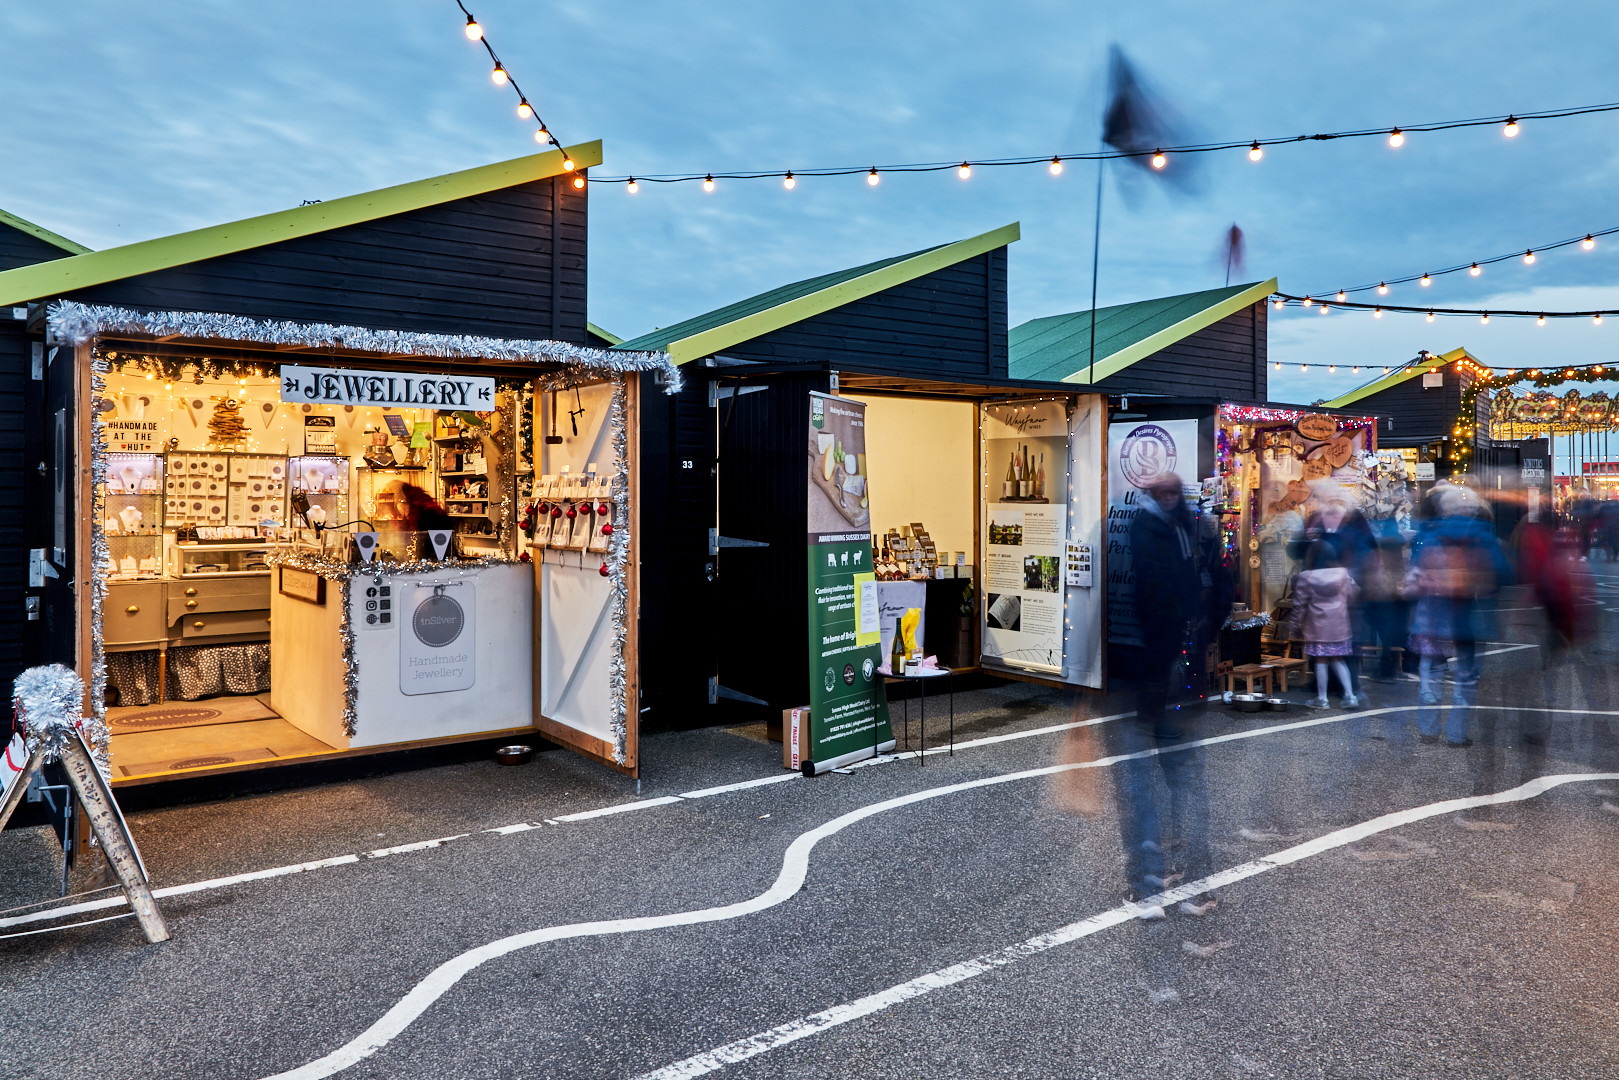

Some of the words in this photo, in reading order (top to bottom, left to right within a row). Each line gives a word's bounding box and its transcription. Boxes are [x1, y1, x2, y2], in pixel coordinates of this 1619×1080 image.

[303, 372, 474, 406] JEWELLERY
[108, 422, 158, 430] #HANDMADE
[114, 432, 125, 440] AT
[135, 432, 152, 441] THE
[127, 443, 144, 451] HUT
[682, 460, 693, 469] 33
[421, 616, 458, 626] inSilver
[409, 652, 468, 667] Handmade
[412, 668, 465, 680] Jewellery
